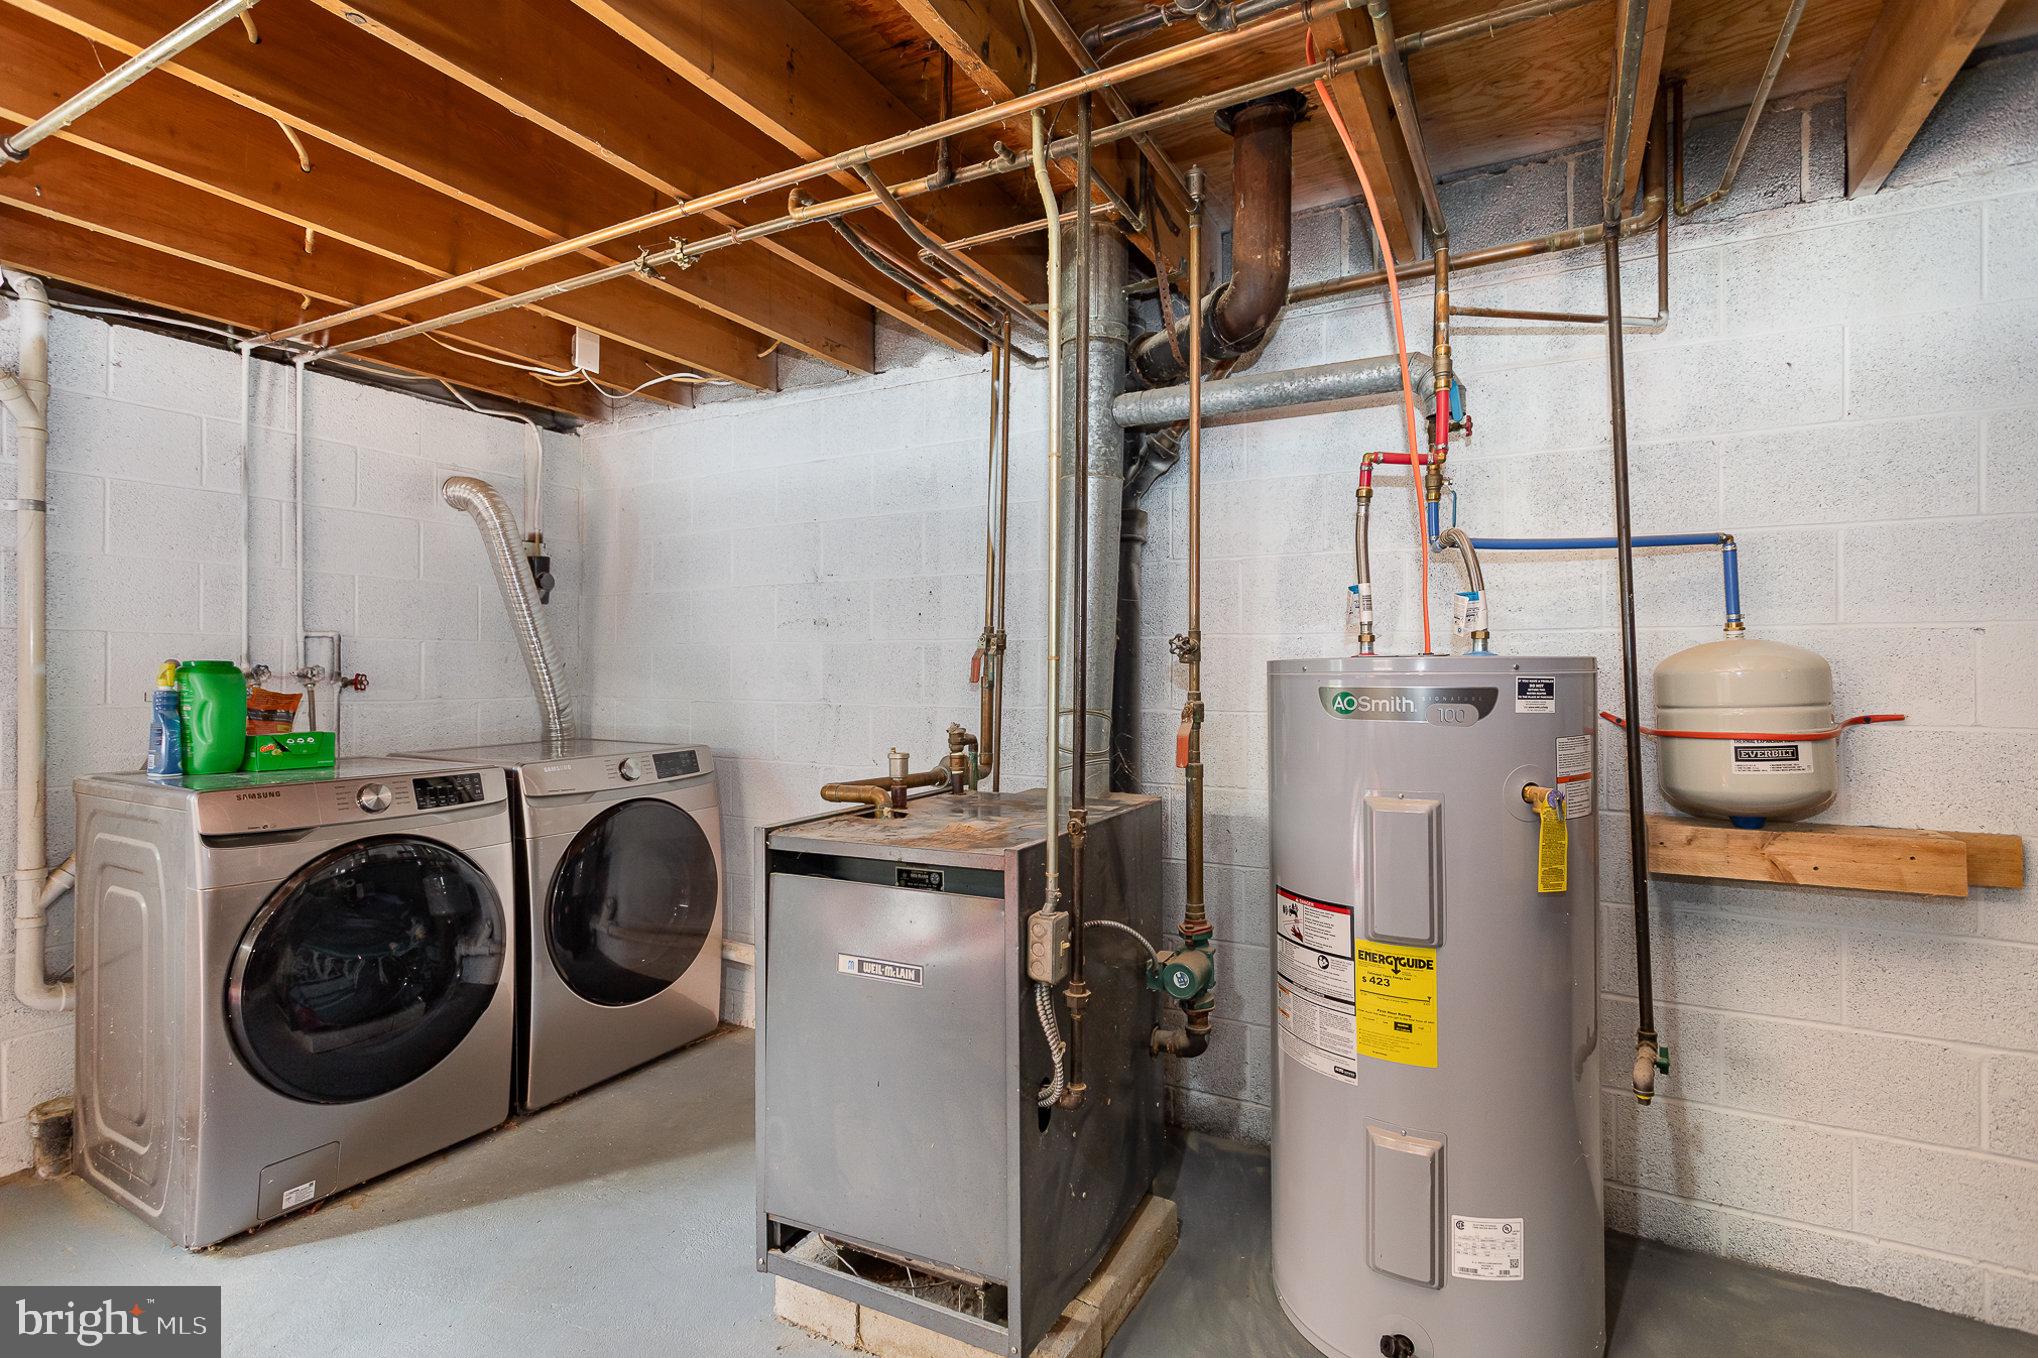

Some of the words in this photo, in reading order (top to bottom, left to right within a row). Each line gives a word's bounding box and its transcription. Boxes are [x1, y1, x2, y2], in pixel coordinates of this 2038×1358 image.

[1438, 708, 1465, 723] 100
[1740, 749, 1794, 758] EVERBILT
[543, 765, 571, 773] SAMSUNG
[236, 790, 281, 801] SAMSUNG
